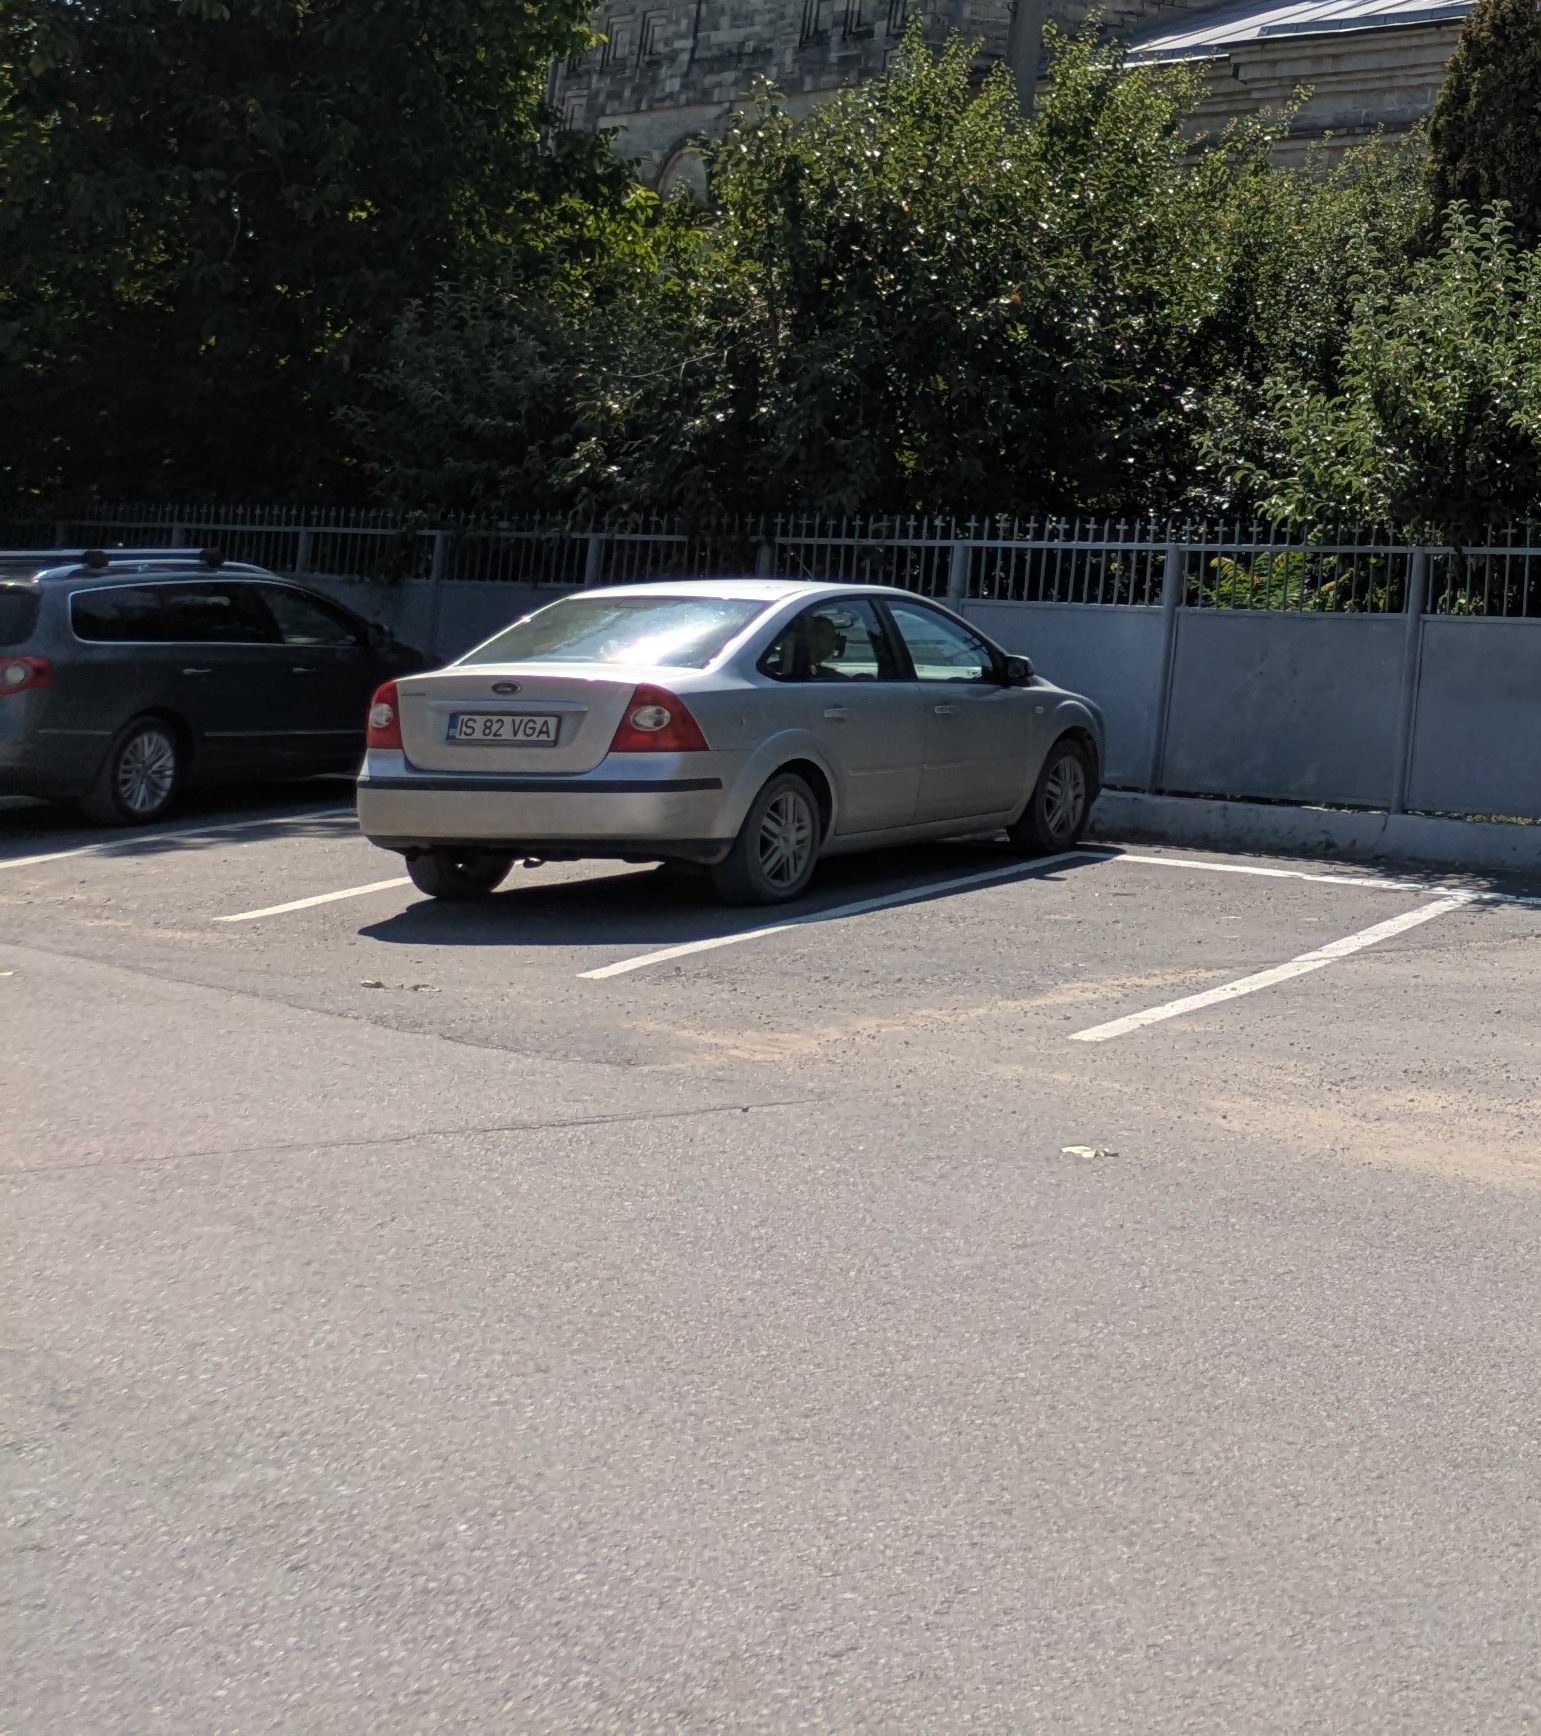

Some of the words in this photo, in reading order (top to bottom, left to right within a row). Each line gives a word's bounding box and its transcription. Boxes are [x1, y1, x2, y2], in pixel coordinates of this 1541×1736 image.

[458, 717, 477, 737] IS
[482, 718, 504, 738] 82
[511, 718, 551, 738] VGA
